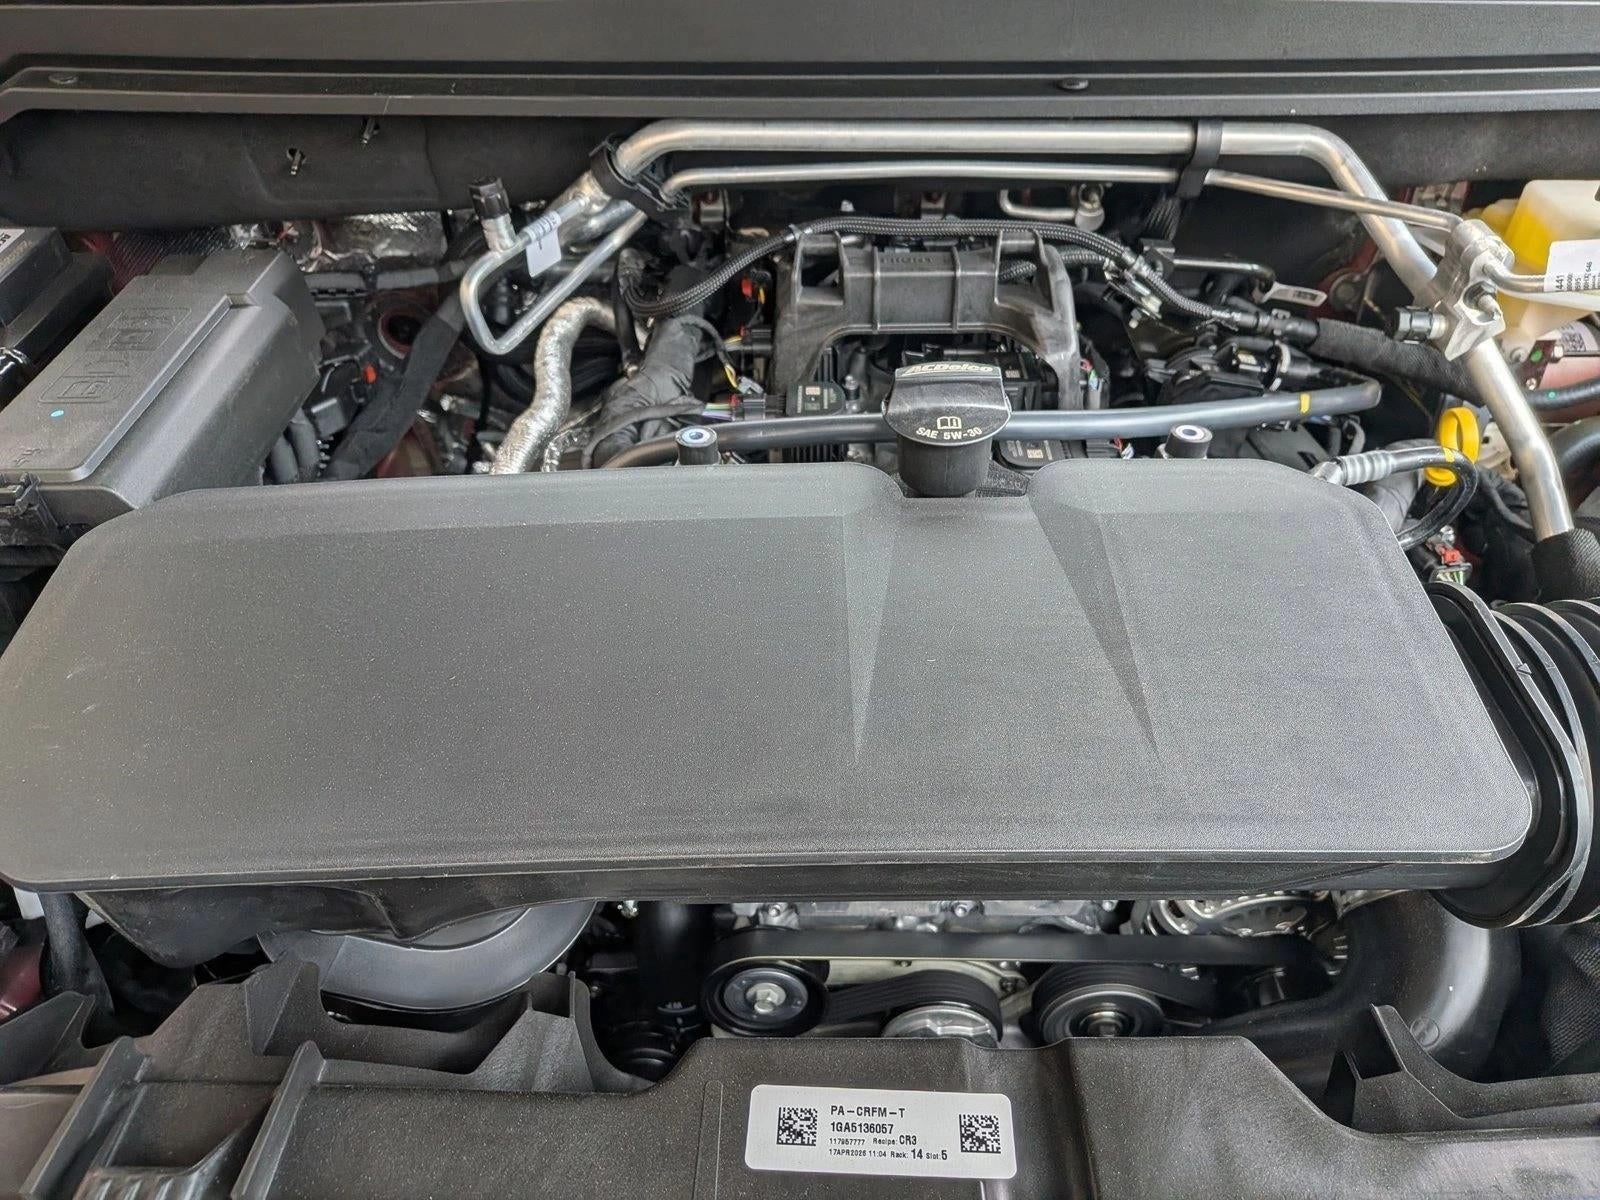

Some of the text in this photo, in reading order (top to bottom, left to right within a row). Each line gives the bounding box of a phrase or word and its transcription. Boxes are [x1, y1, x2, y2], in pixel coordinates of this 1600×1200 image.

[901, 363, 994, 376] ACDelco
[916, 427, 983, 440] SAE 5W-30
[830, 1122, 894, 1134] 1GA5136057
[873, 1137, 898, 1146] Recipe:
[899, 1135, 917, 1145] CR3
[868, 1150, 887, 1158] 11:04
[890, 1151, 909, 1159] Rack:
[911, 1148, 924, 1160] 14
